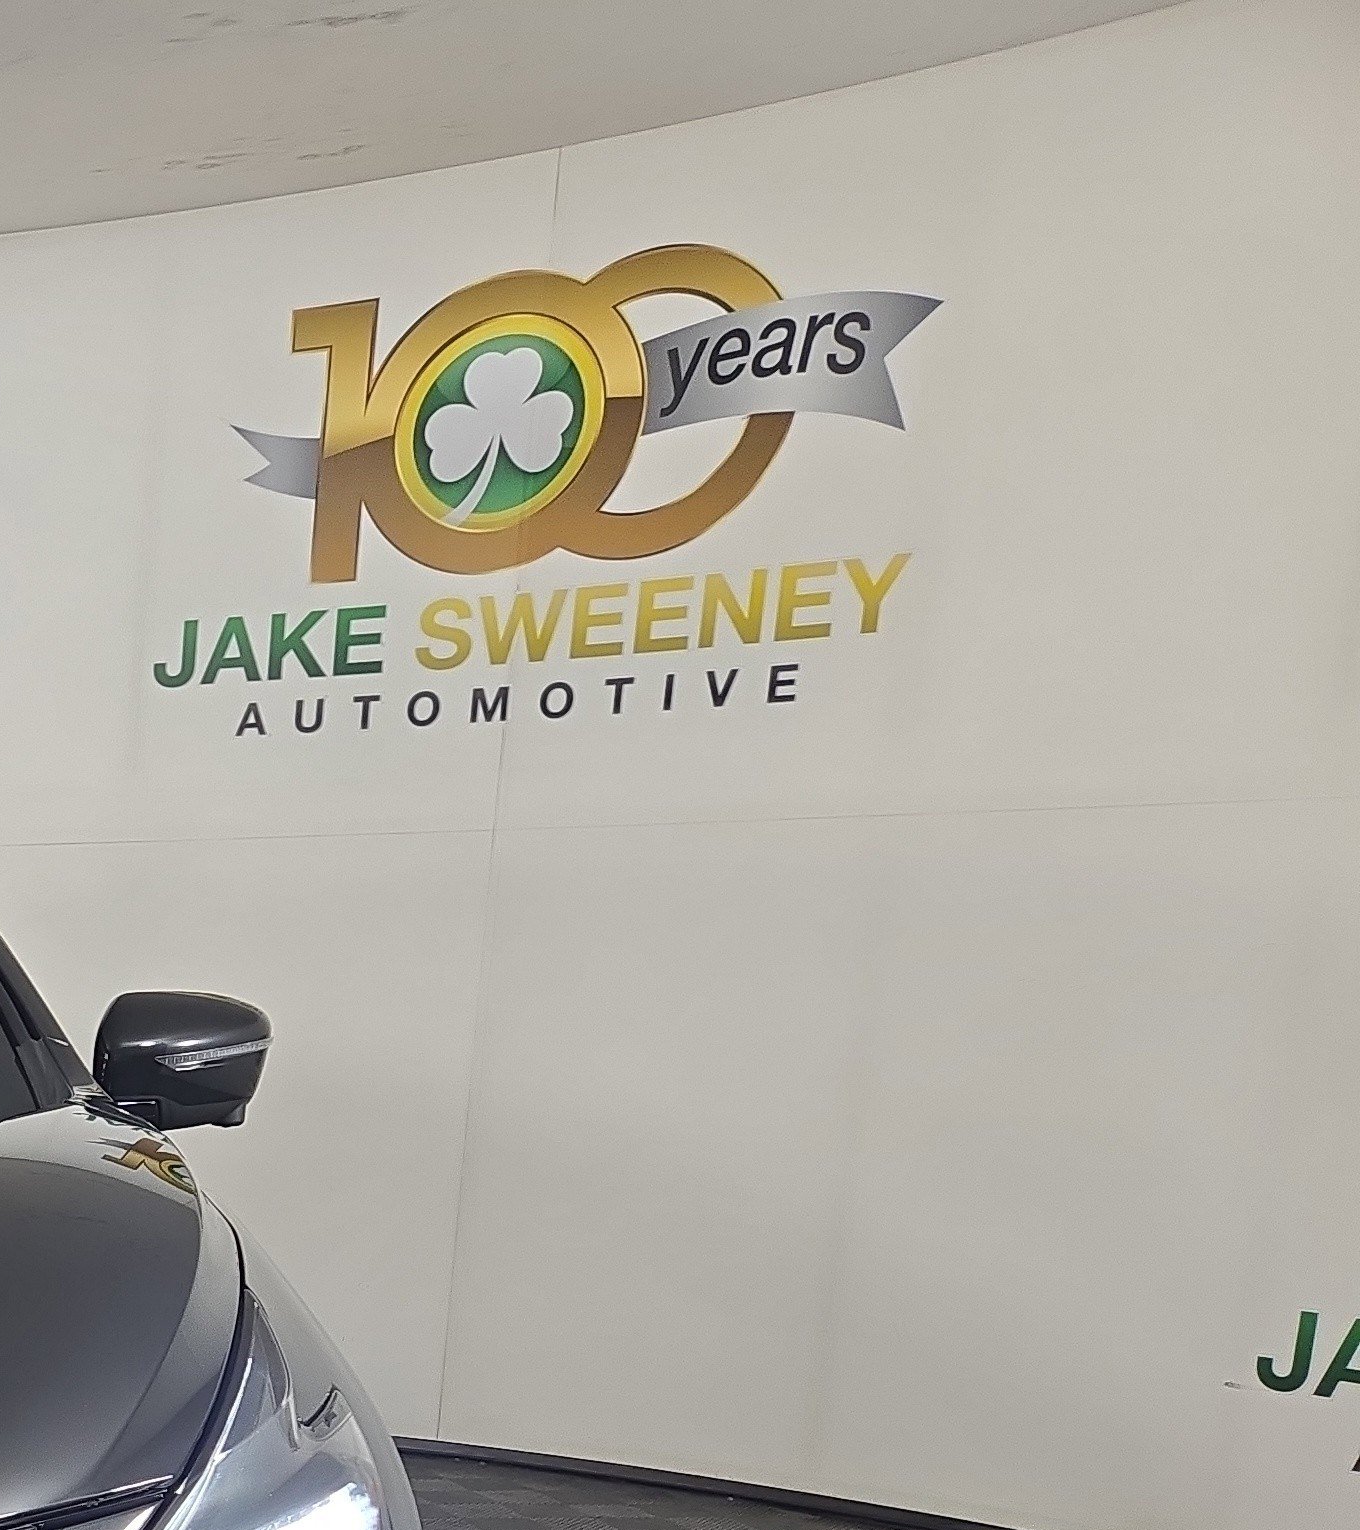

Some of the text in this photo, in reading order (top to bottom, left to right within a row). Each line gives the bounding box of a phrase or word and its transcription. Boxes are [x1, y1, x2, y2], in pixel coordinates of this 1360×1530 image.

[291, 243, 871, 584] 100 years
[152, 553, 914, 690] JAKE SWEENEY
[236, 663, 801, 738] AUTOMOTIVE
